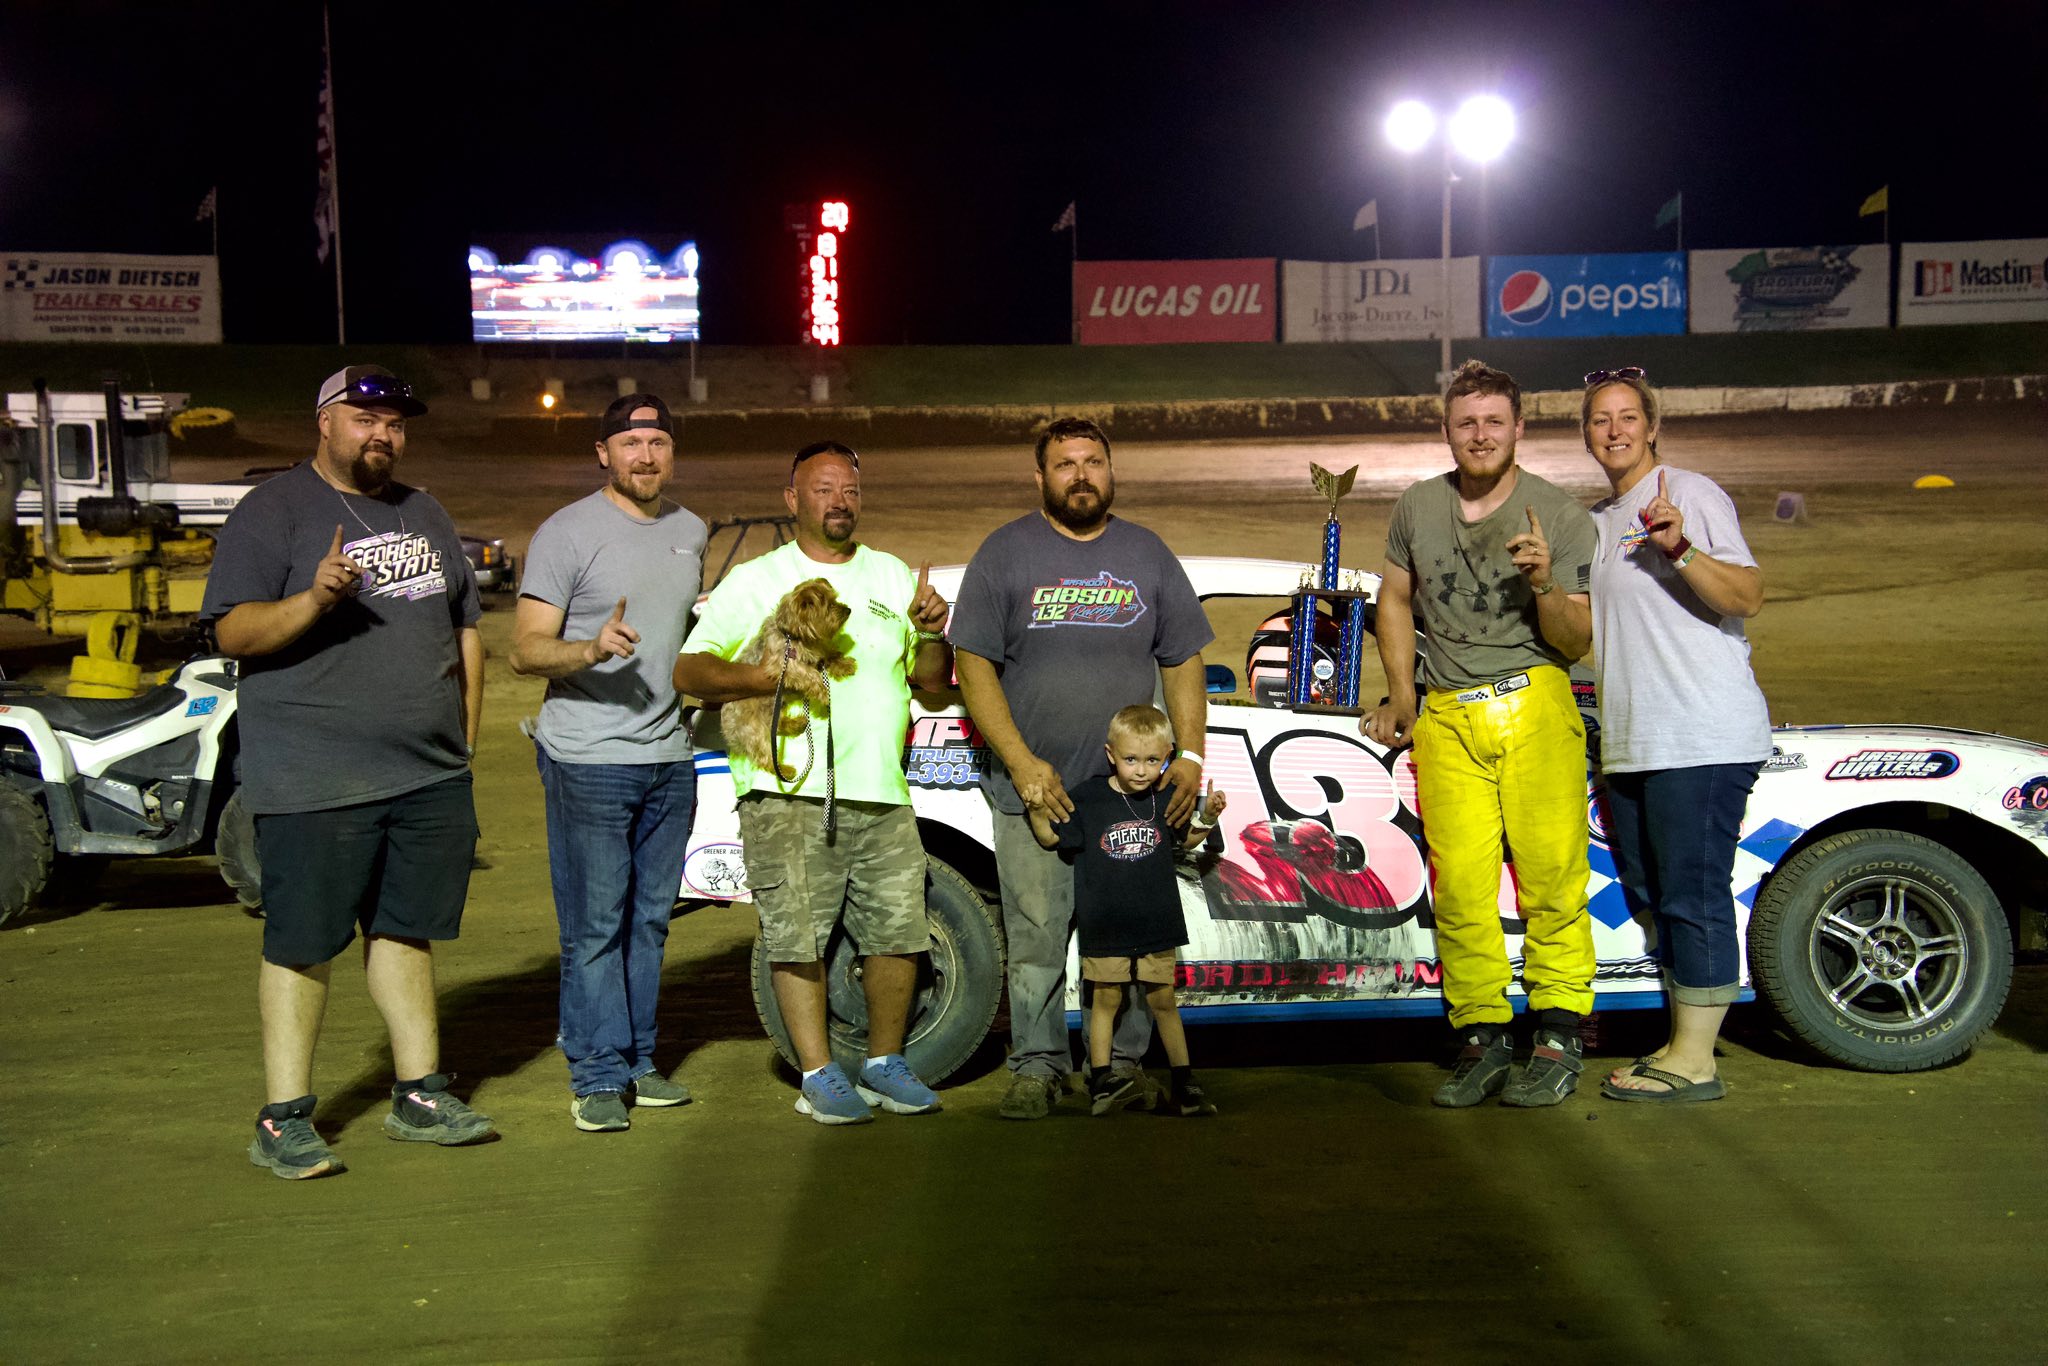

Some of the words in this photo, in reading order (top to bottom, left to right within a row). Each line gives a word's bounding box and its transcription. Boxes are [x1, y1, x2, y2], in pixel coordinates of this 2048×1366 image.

[43, 268, 111, 285] JASON
[118, 269, 201, 287] DIETSCH
[1960, 258, 2032, 286] Mastin
[32, 292, 123, 309] TRAILER
[128, 294, 202, 313] SALES
[1089, 285, 1203, 317] LUCAS
[1209, 283, 1262, 315] OIL
[1560, 275, 1670, 318] pepsi
[350, 536, 433, 569] GEORGIA
[377, 551, 444, 585] STATE
[1062, 579, 1108, 587] BRANDON
[1032, 587, 1135, 605] GIBSON
[1036, 604, 1068, 621] 132
[1069, 604, 1119, 622] Racing
[184, 697, 217, 717] 132
[1764, 756, 1803, 767] PHIX
[1848, 752, 1931, 762] JASON
[1828, 761, 1942, 778] WATERS
[1858, 771, 1929, 779] TUNING
[1108, 827, 1155, 851] PIERCE
[1122, 843, 1142, 855] 32
[1875, 1017, 1956, 1046] Radial
